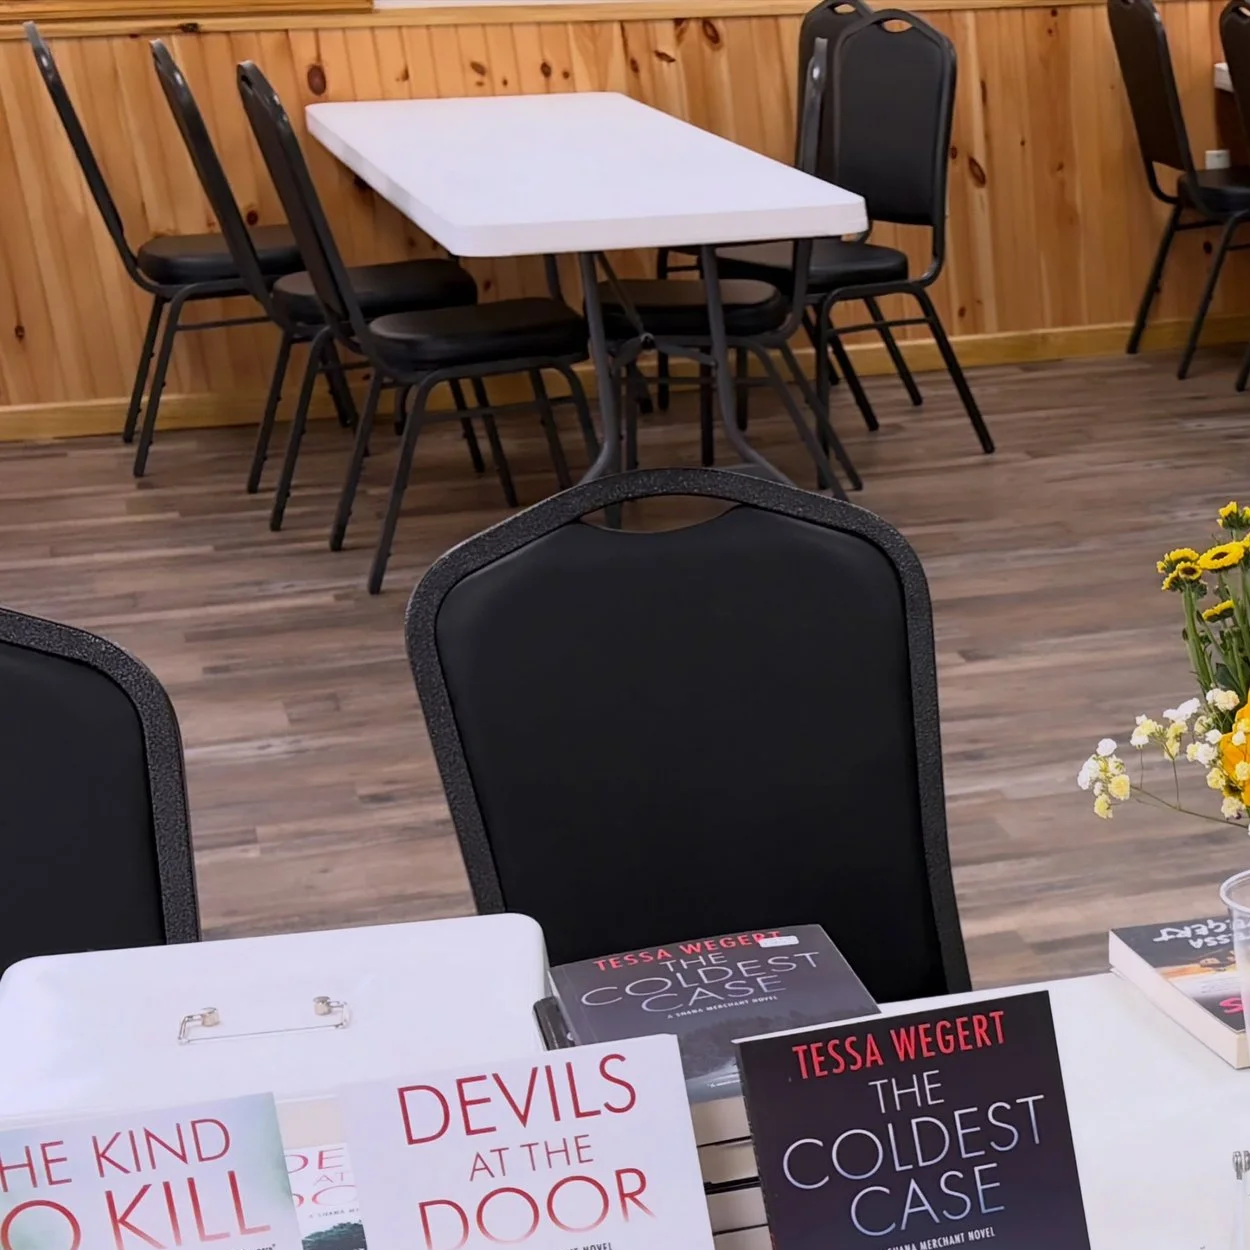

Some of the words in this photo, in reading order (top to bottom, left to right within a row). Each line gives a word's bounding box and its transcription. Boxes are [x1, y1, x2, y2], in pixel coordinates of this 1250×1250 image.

[581, 951, 820, 1006] COLDEST
[592, 949, 672, 972] TESSA
[658, 952, 729, 973] THE
[641, 974, 787, 1012] CASE
[792, 1033, 885, 1080] TESSA
[889, 1011, 1005, 1062] WEGERT
[397, 1053, 636, 1145] DEVILS
[868, 1070, 945, 1114] THE
[92, 1118, 231, 1178] KIND
[469, 1147, 510, 1182] AT
[520, 1134, 594, 1171] THE
[783, 1094, 1045, 1190] COLDEST
[850, 1162, 1005, 1237] CASE
[968, 1227, 996, 1242] NOVEL
